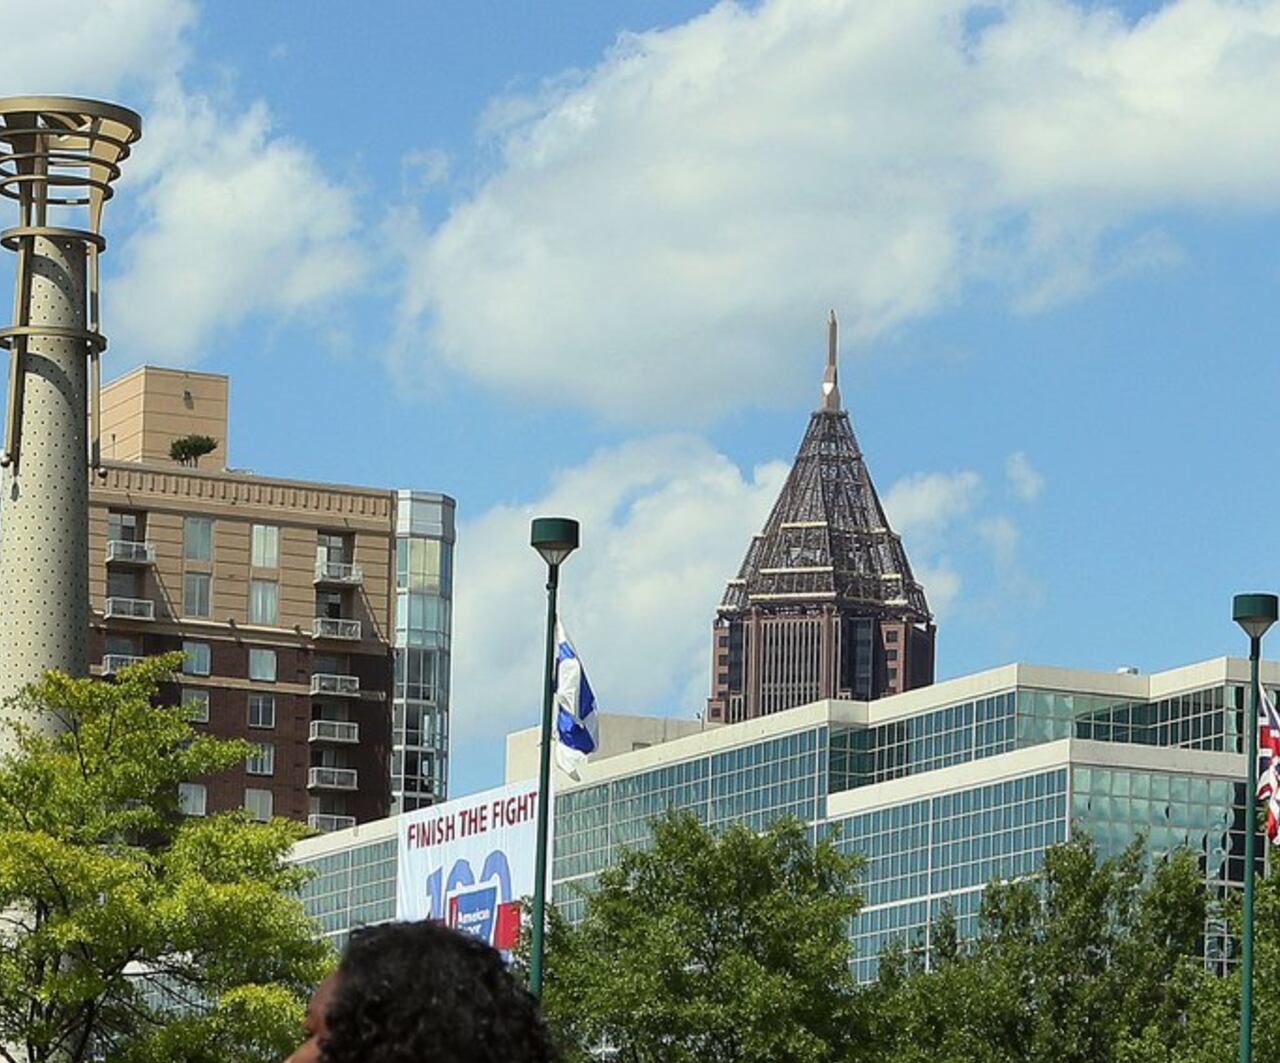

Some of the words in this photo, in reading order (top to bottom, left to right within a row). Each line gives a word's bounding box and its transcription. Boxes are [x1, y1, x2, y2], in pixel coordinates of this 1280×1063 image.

[407, 814, 456, 850] FINISH
[459, 805, 488, 838] THE
[491, 791, 538, 829] FIGHT
